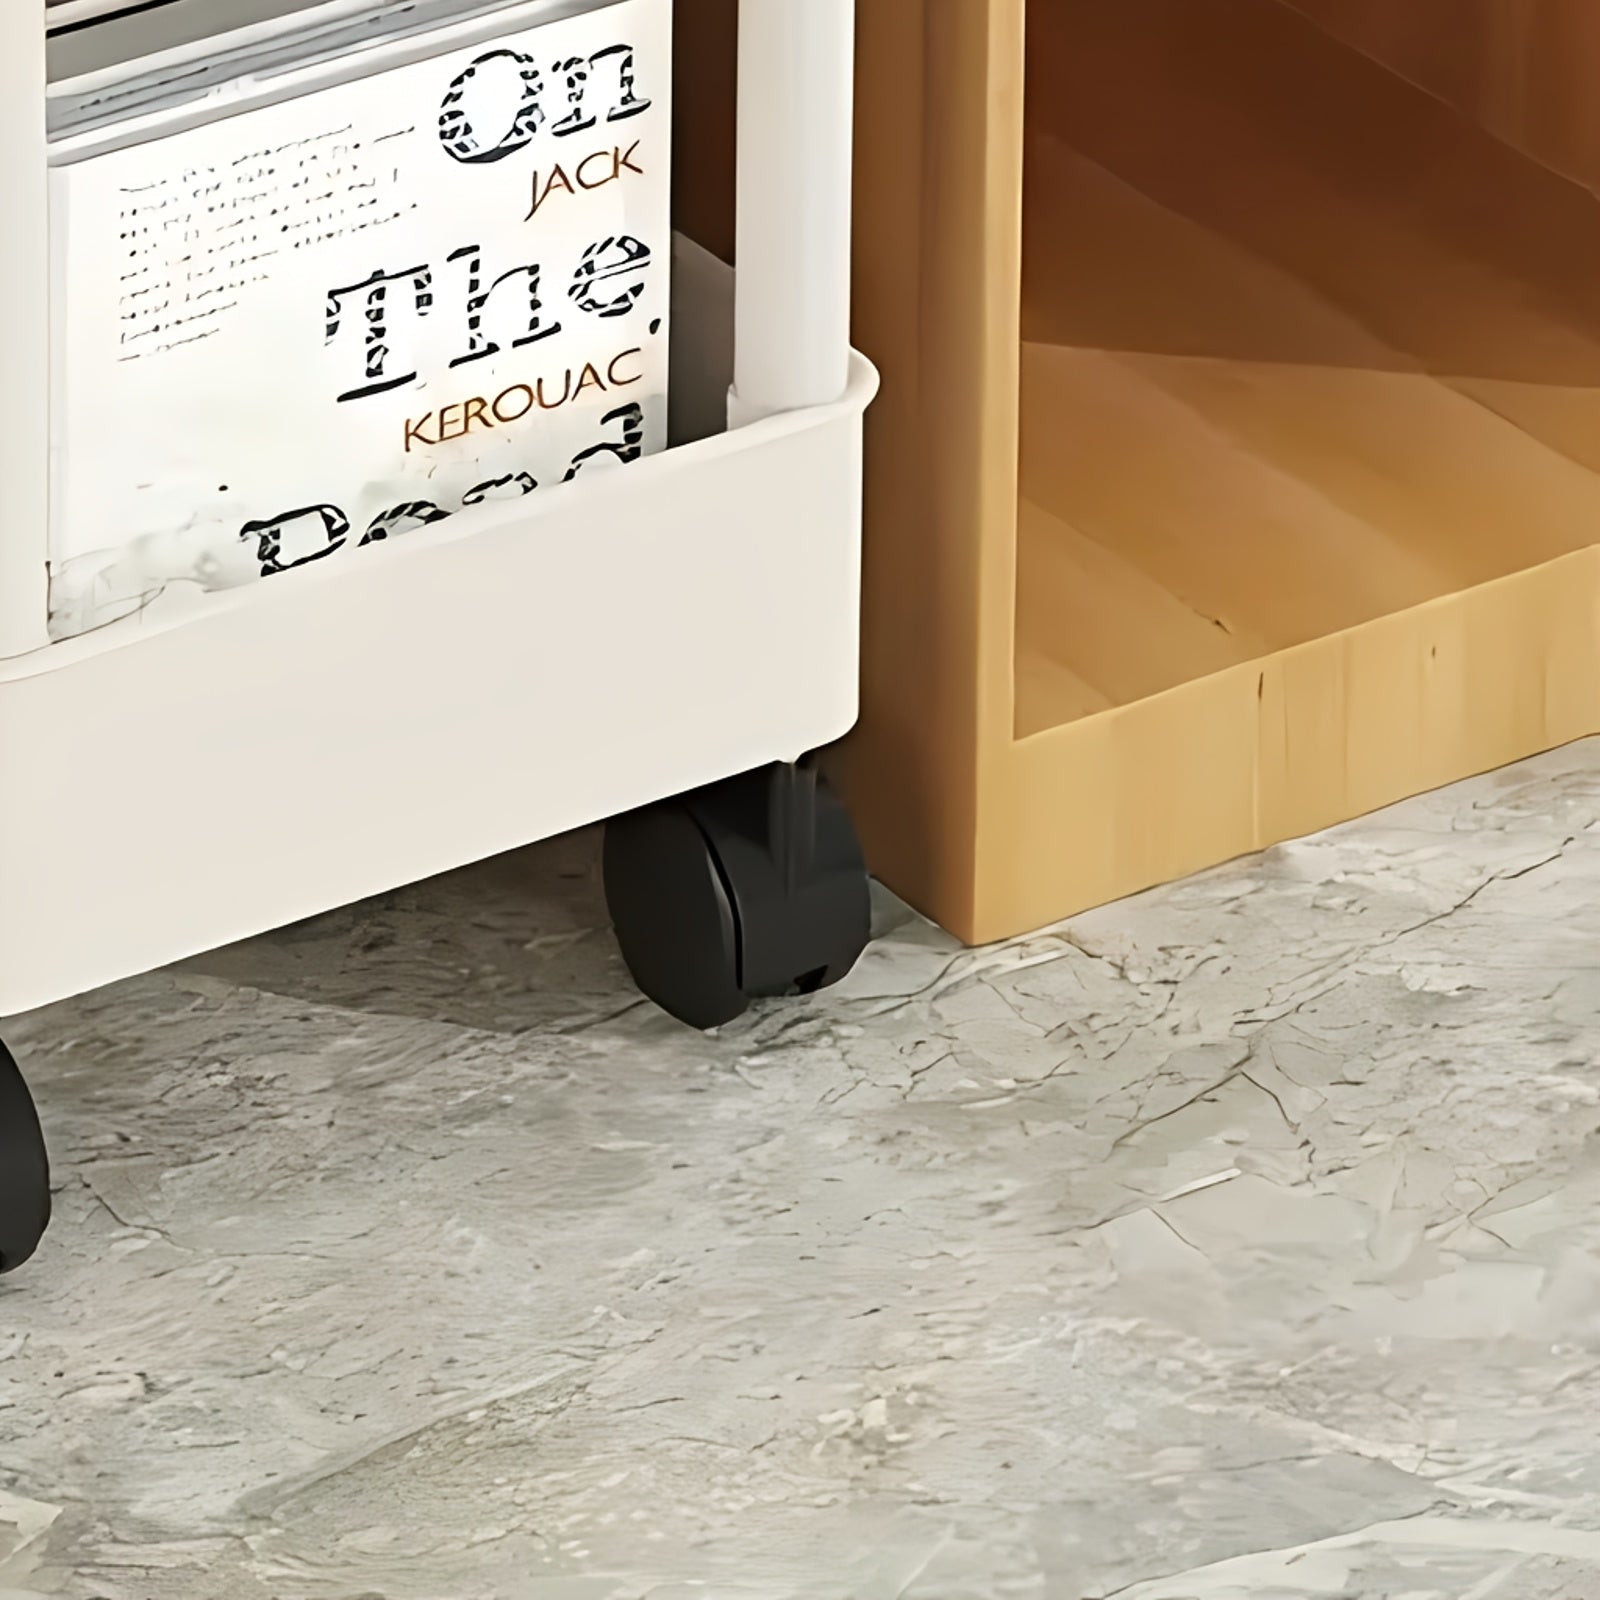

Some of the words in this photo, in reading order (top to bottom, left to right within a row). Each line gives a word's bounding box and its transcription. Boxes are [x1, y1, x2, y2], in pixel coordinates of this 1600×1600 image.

[437, 43, 653, 164] On
[523, 138, 644, 222] JACK
[403, 347, 643, 453] KEROUAC
